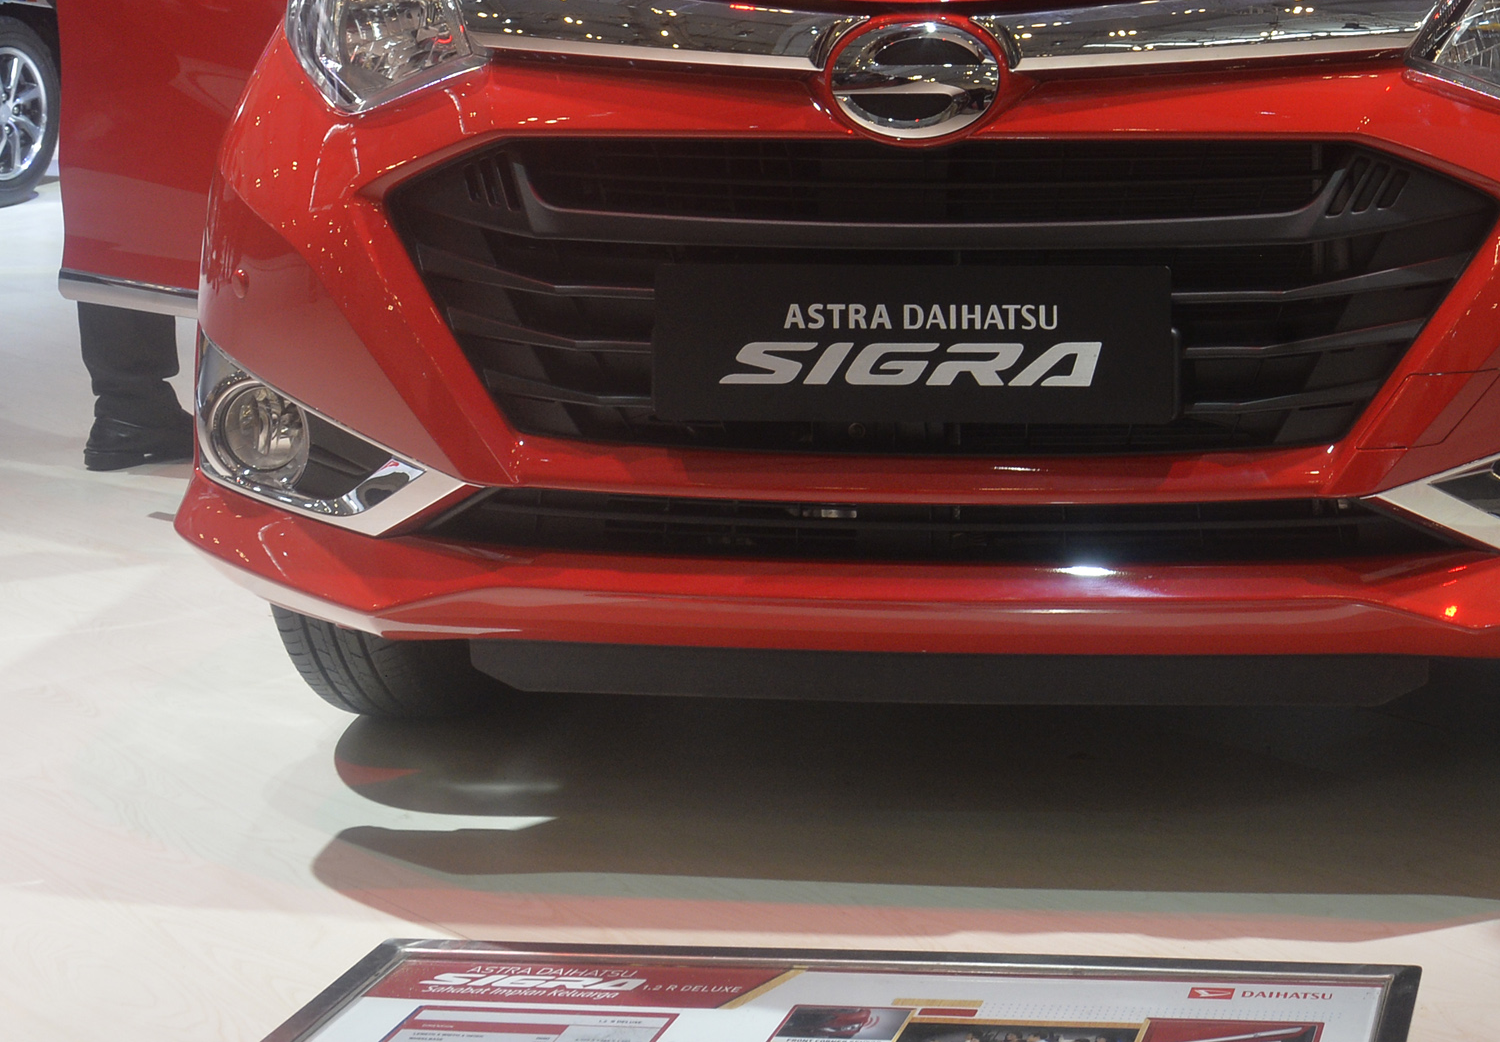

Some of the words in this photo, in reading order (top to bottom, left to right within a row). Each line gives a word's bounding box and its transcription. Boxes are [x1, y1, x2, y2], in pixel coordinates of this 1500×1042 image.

[783, 303, 893, 330] ASTRA
[903, 304, 1058, 331] DAIHATSU
[718, 341, 1103, 388] SIGRA
[467, 965, 532, 975] ASTRA
[535, 967, 639, 978] DAIHATSU
[419, 972, 647, 991] SIGRA
[422, 985, 490, 994] Sahabat
[490, 987, 547, 997] Impian
[547, 989, 619, 1000] Keluarga
[681, 985, 743, 994] DELUXE
[1241, 990, 1333, 1001] DAIHATSU
